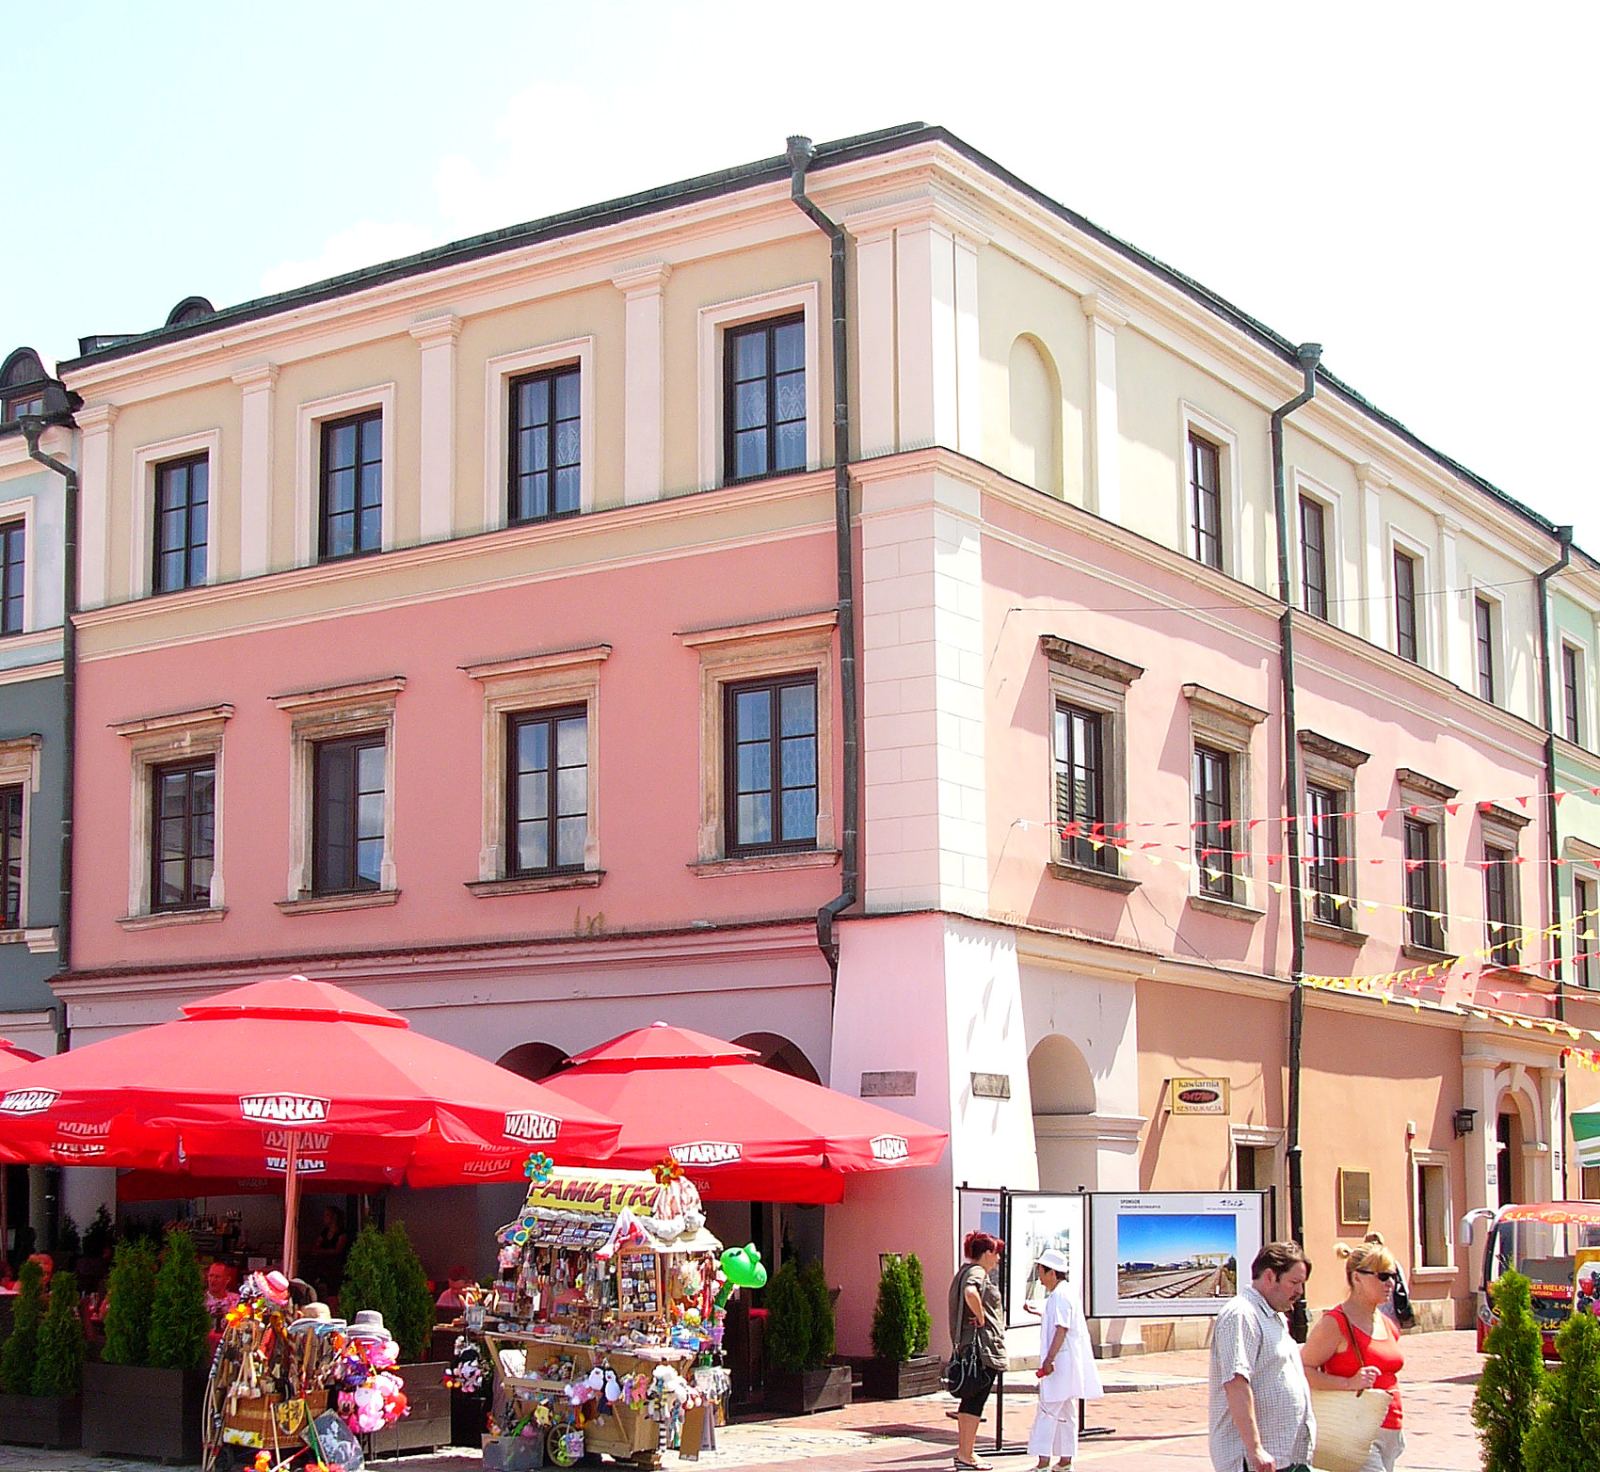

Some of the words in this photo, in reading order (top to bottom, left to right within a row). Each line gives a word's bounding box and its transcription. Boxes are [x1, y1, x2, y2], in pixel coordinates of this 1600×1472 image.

[1178, 1080, 1219, 1088] kawiarnia
[0, 1091, 56, 1110] WARKA
[242, 1097, 325, 1119] WARKA
[505, 1114, 557, 1139] WARKA
[671, 1143, 740, 1164] WARKA
[873, 1138, 908, 1160] WARKA
